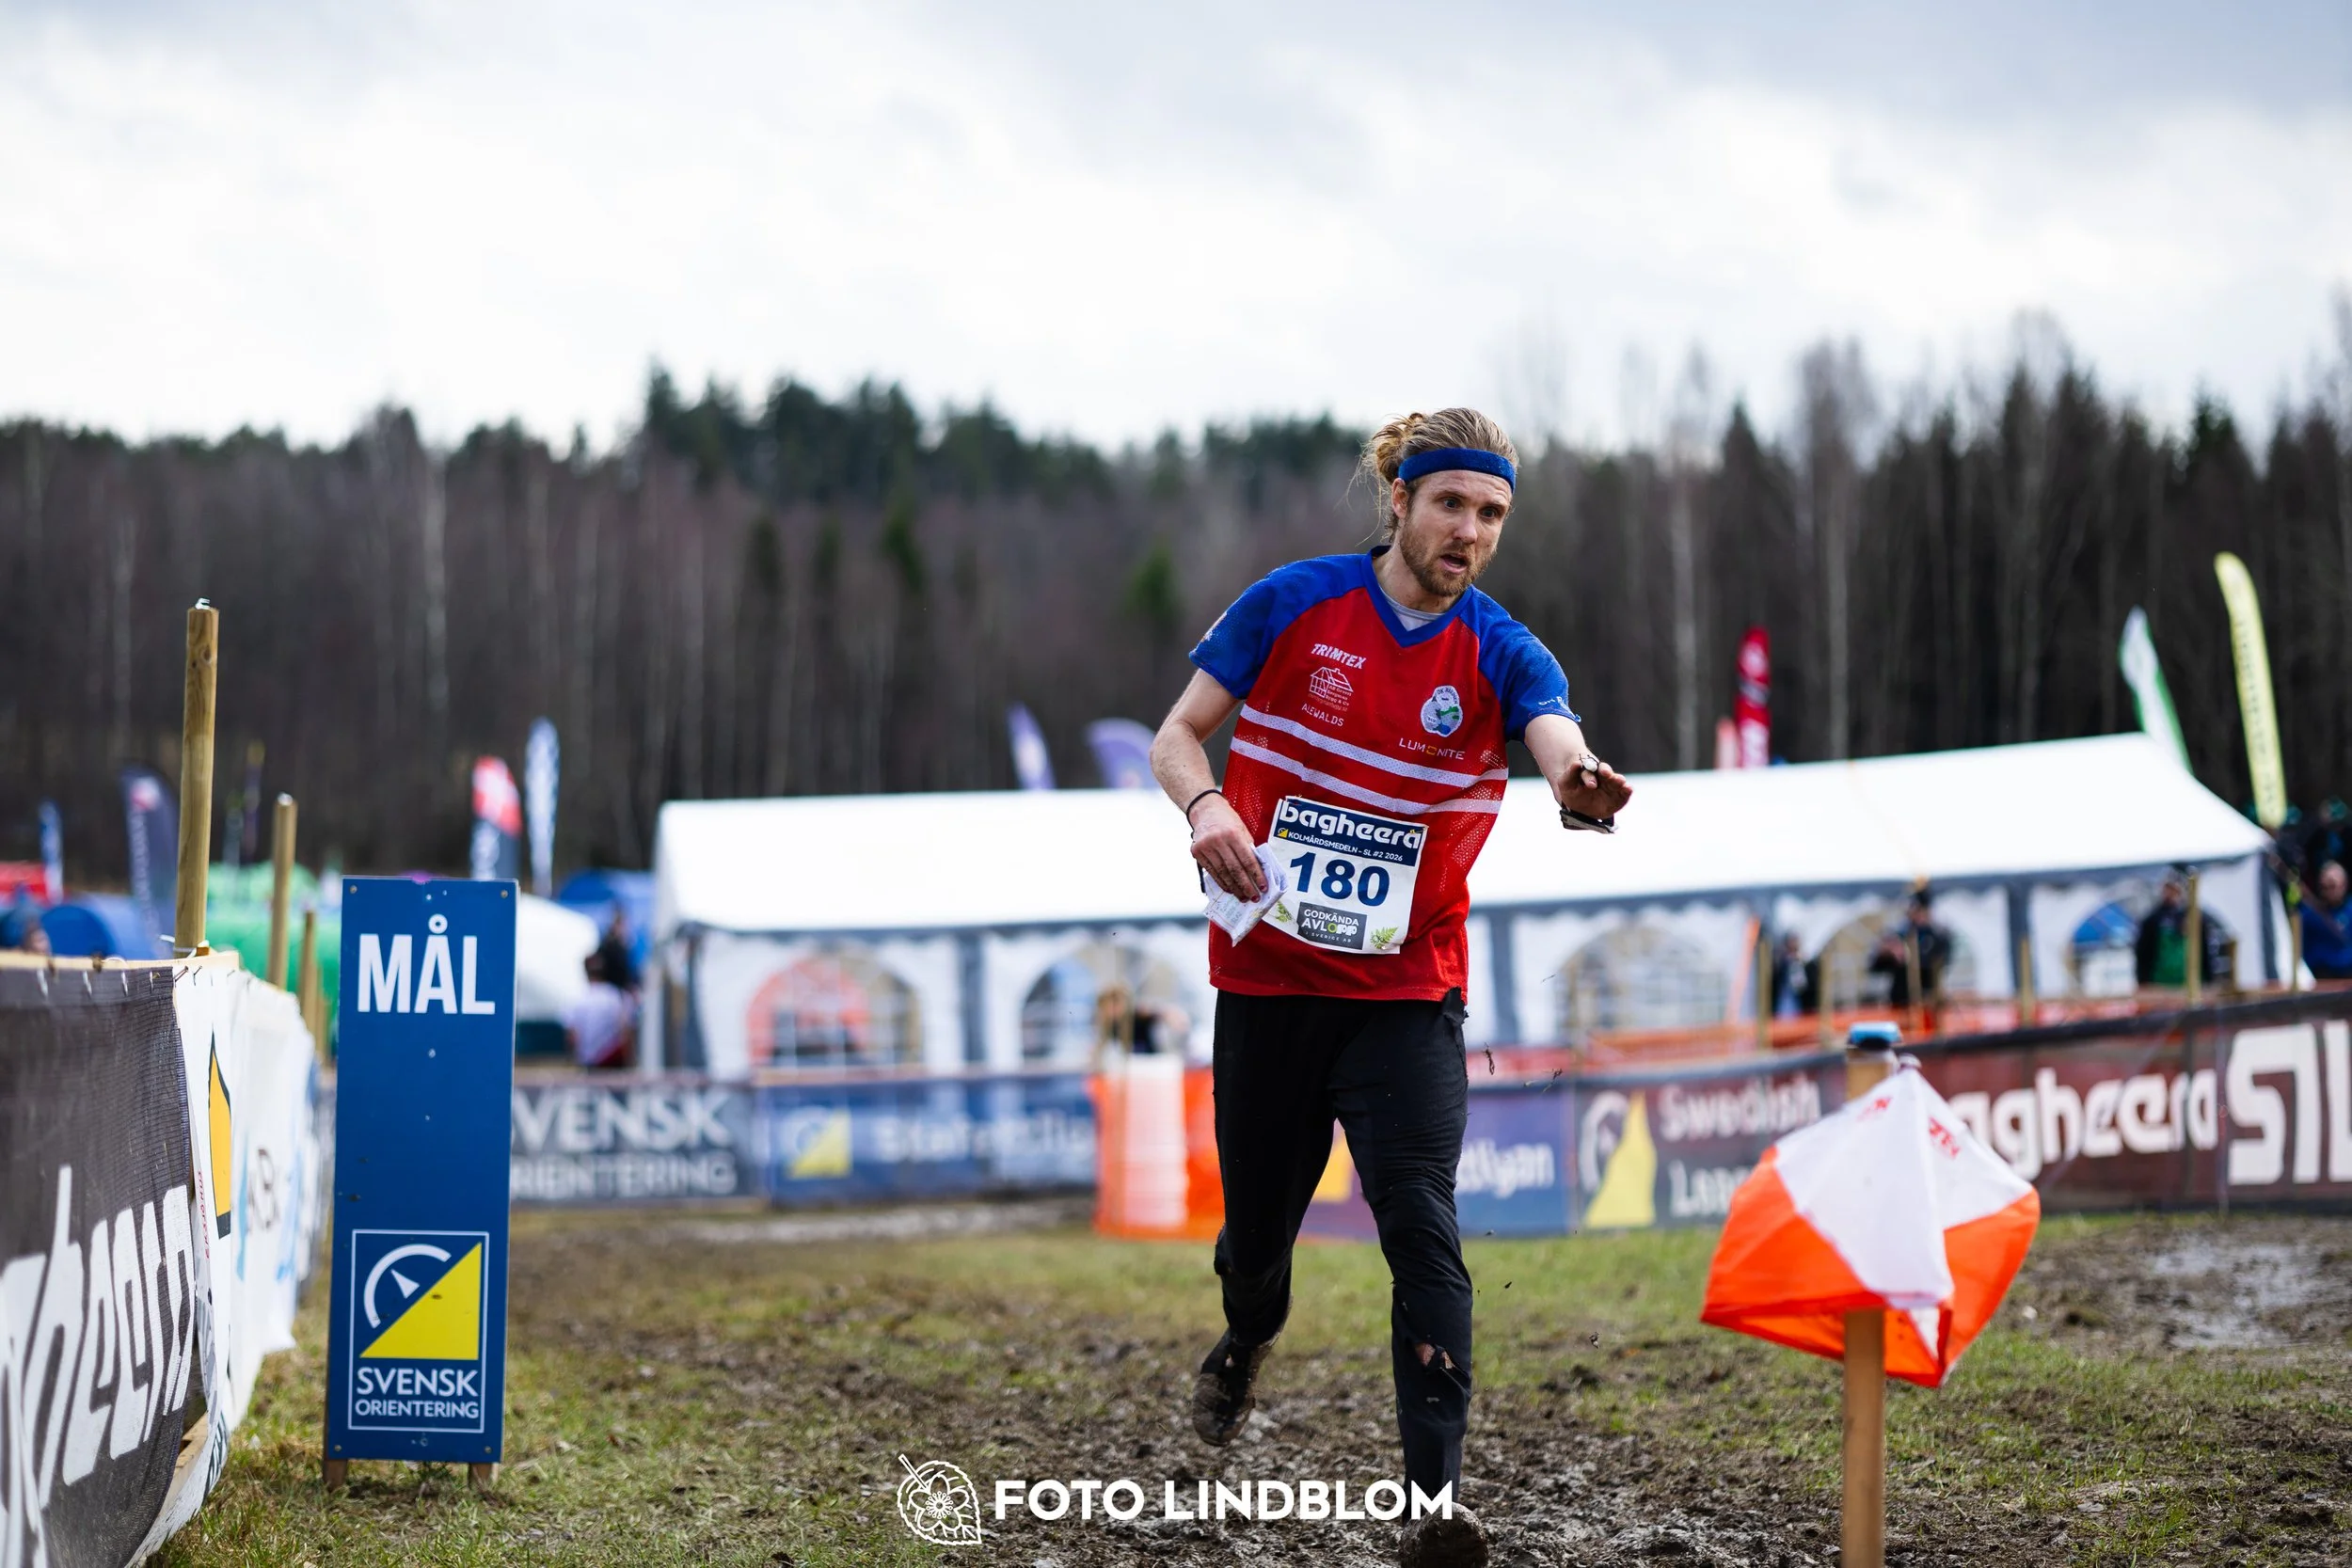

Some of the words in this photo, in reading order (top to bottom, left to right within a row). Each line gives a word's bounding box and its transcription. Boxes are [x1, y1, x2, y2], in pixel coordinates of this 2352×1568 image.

[1311, 643, 1367, 669] TRIMTEX
[1301, 703, 1344, 727] ALEWALDS
[1398, 737, 1466, 760] LUMONITE
[1279, 800, 1422, 849] bagheera
[1288, 832, 1358, 854] KOLMÅRDSMEDELN
[1363, 848, 1372, 857] SL
[1373, 850, 1384, 859] #2
[1385, 852, 1403, 862] 2026
[1290, 851, 1390, 907] 180
[1301, 918, 1358, 936] AVLOPP
[1304, 909, 1359, 927] GODKÄNDA
[358, 913, 496, 1015] MÅL
[512, 1088, 731, 1151] VENSK
[1948, 1067, 2217, 1182] agheera
[511, 1153, 736, 1200] RIENTERING
[357, 1366, 479, 1398] SVENSK
[355, 1398, 480, 1419] ORIENTERING
